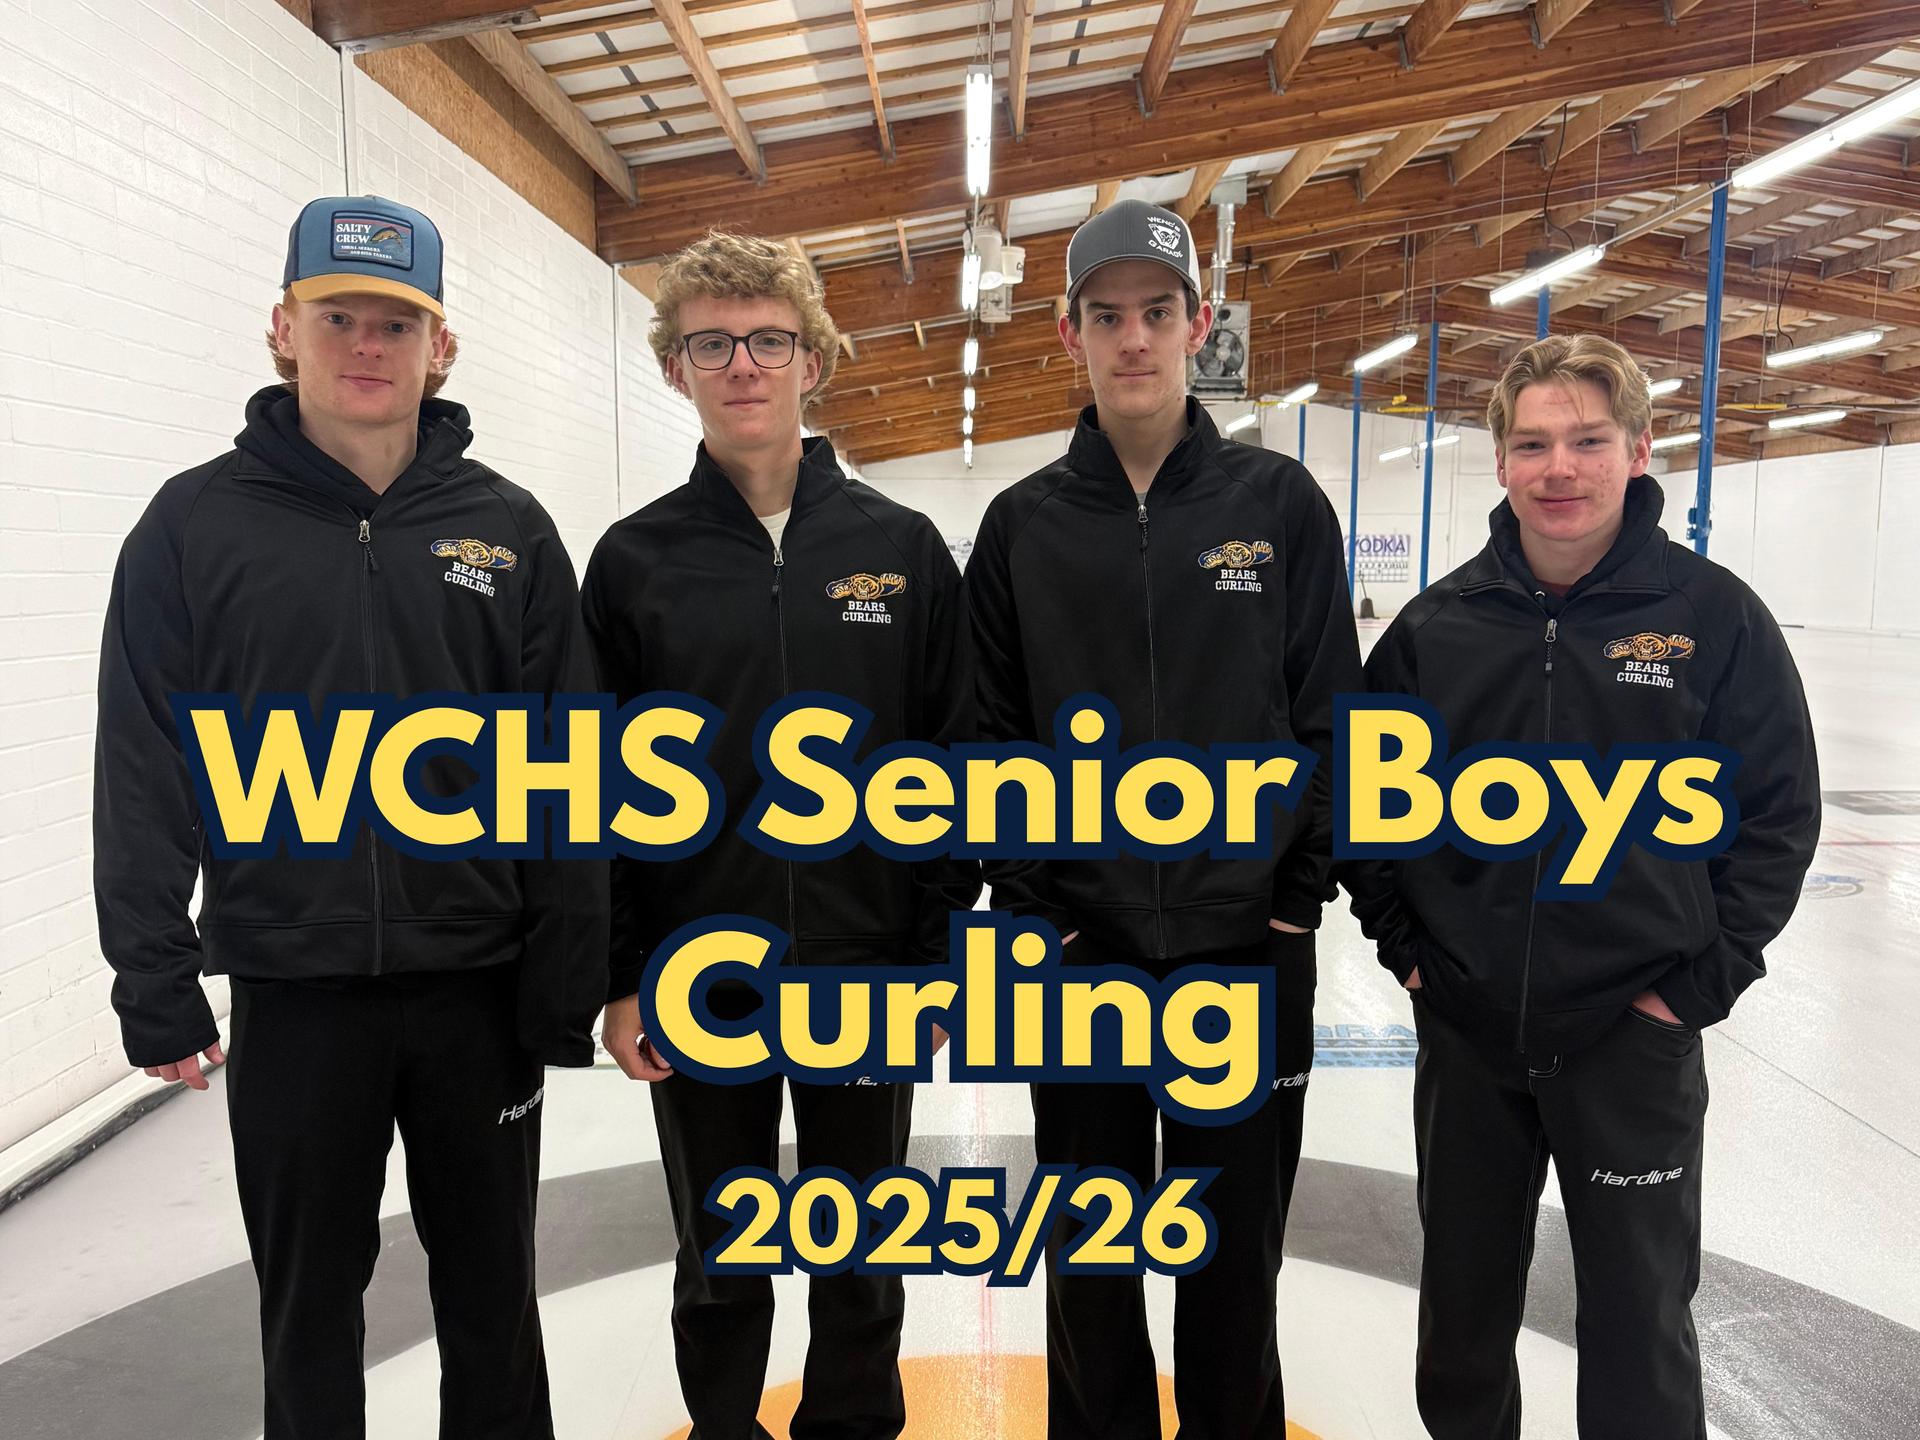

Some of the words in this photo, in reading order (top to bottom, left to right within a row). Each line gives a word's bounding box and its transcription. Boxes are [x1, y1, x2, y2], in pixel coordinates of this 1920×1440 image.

[336, 223, 372, 234] SALTY
[335, 234, 371, 244] CREW
[452, 561, 492, 584] BEARS
[1220, 569, 1257, 580] BEARS
[444, 571, 496, 597] CURLING
[1215, 580, 1262, 592] CURLING
[848, 601, 886, 612] BEARS
[842, 611, 892, 624] CURLING
[1624, 661, 1670, 676] BEARS
[1616, 671, 1674, 689] CURLING
[1590, 1166, 1683, 1187] Hardline
